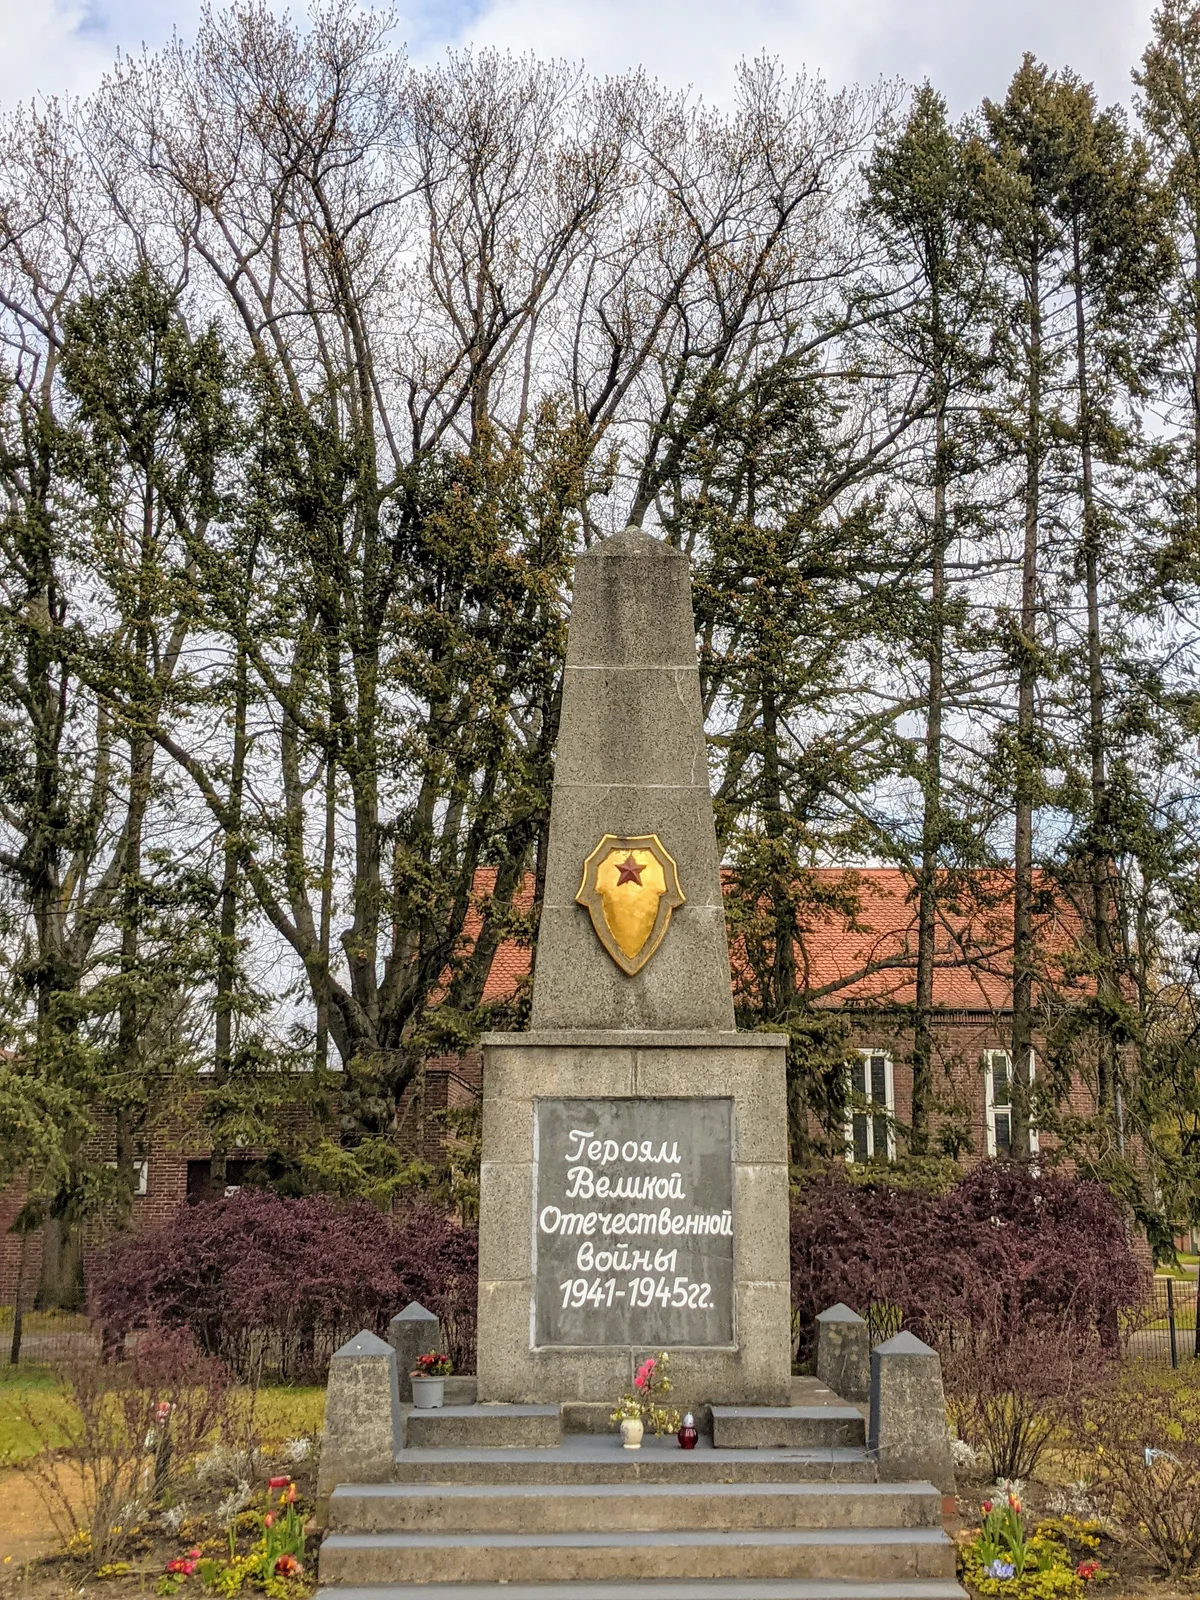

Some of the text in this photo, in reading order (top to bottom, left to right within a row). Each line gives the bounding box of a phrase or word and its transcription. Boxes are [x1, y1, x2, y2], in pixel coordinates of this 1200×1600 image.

[565, 1129, 682, 1166] Героям
[565, 1166, 686, 1200] Великой
[539, 1205, 734, 1236] Отечественной
[576, 1241, 678, 1272] войны
